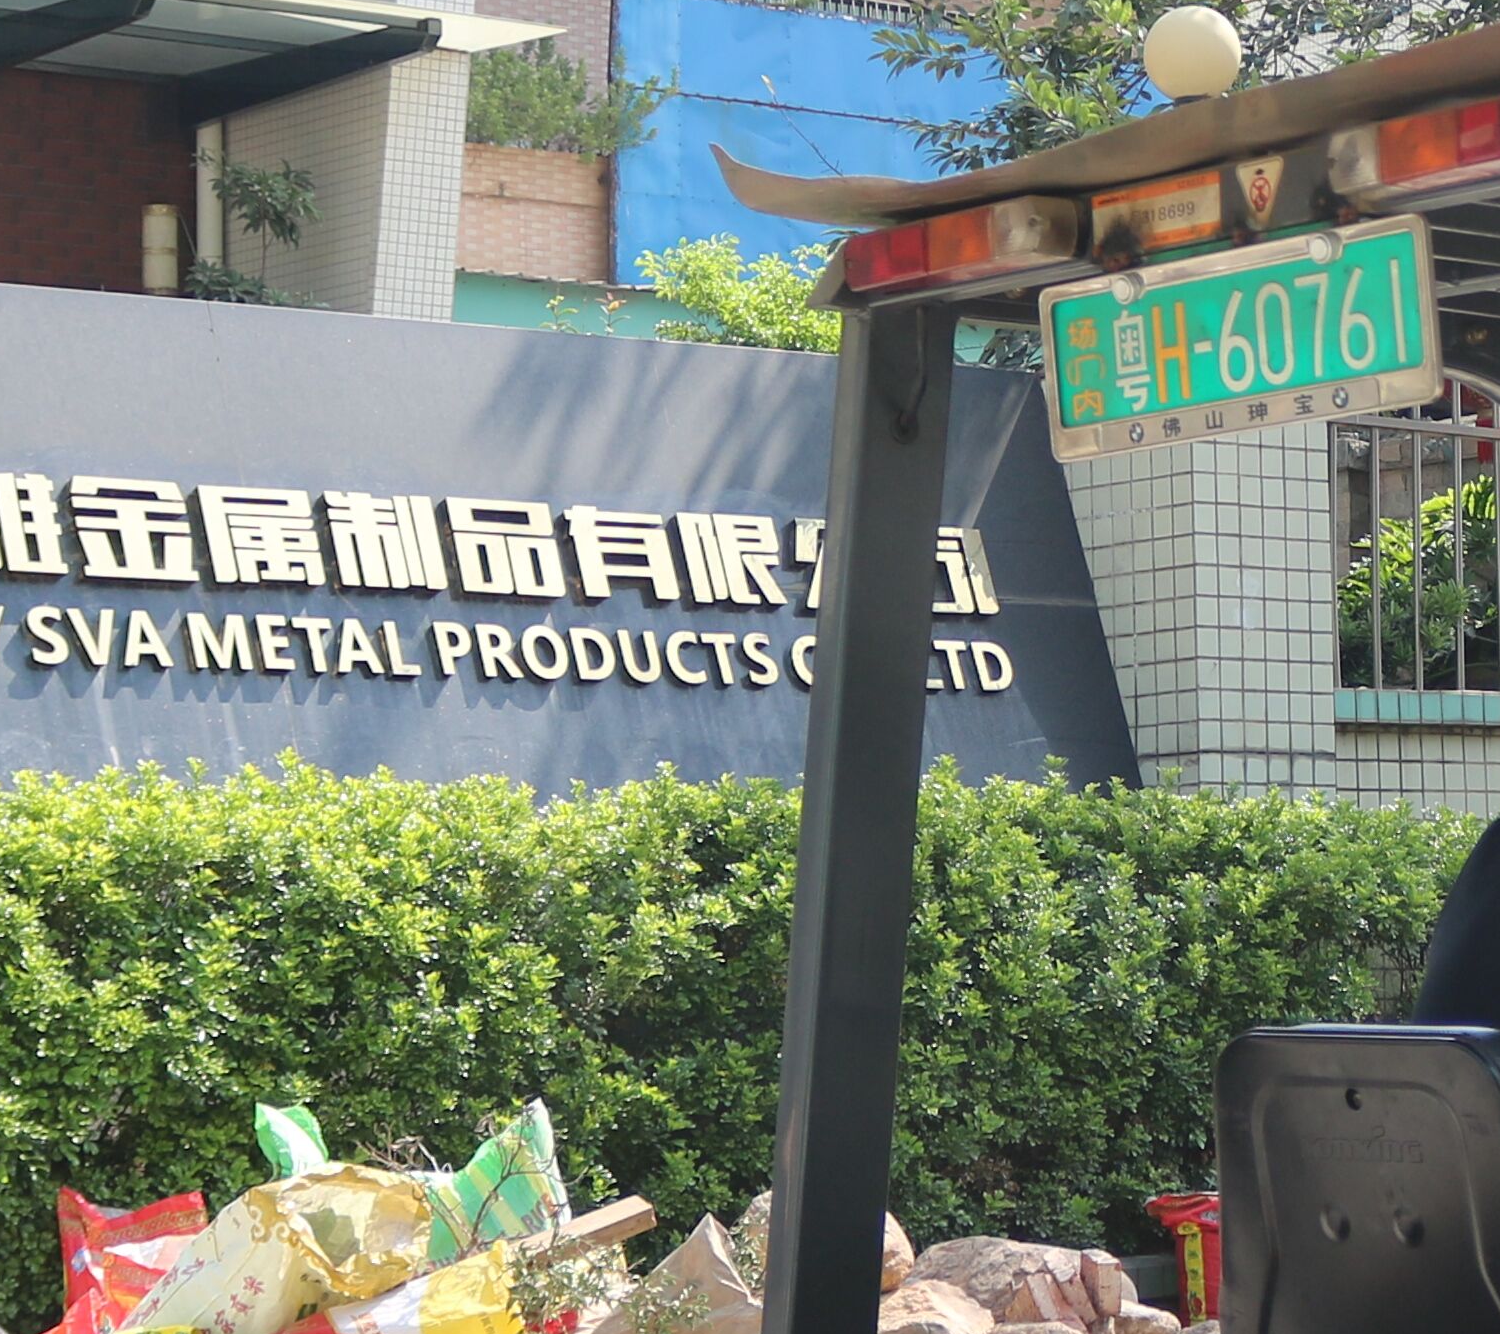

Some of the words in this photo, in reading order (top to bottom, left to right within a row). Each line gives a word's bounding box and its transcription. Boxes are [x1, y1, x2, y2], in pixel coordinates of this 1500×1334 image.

[1114, 258, 1407, 412] 粤H-60761
[1161, 393, 1316, 439] 佛山珅宝
[27, 605, 175, 670] SVA
[185, 609, 422, 679] METAL
[437, 618, 780, 687] PRODUCTS
